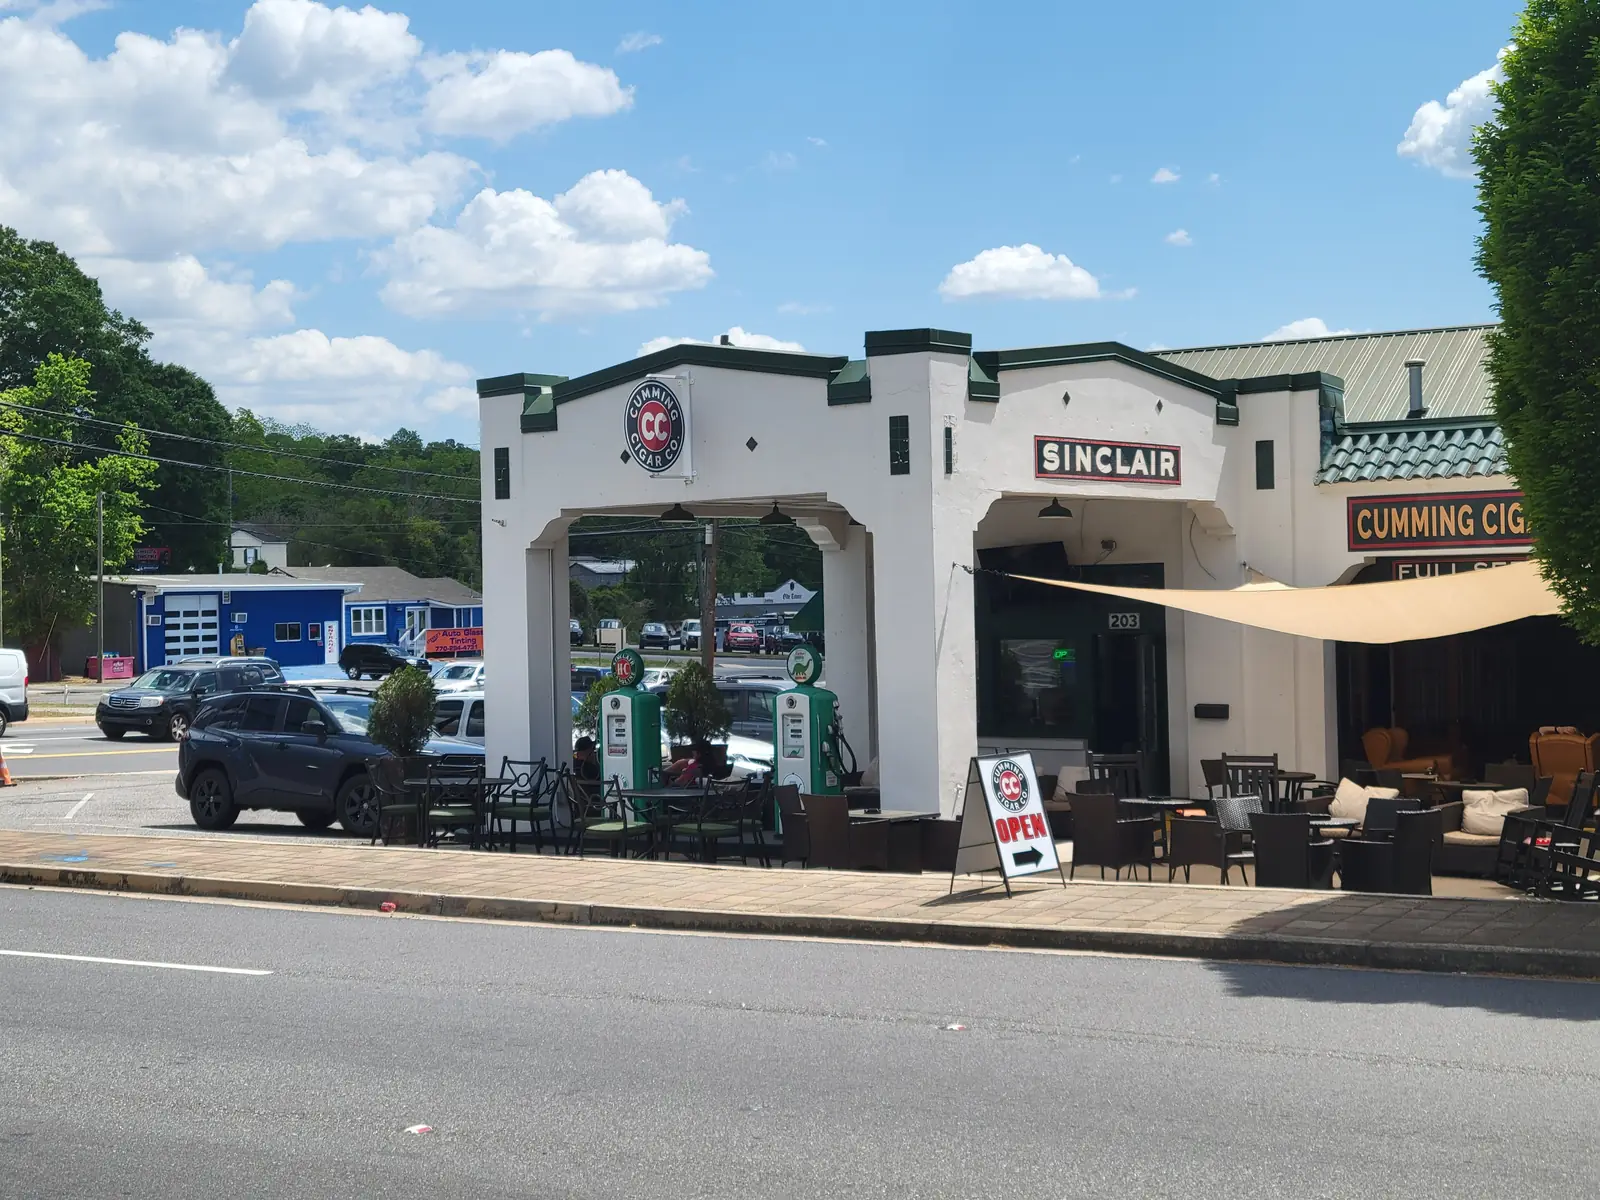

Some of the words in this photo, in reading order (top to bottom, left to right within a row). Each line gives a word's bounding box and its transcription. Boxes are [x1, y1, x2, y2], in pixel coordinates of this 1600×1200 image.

[629, 386, 679, 421] CUMMING
[641, 411, 668, 441] CC
[631, 432, 662, 467] CIGAR
[665, 435, 680, 460] CO.
[1042, 442, 1175, 477] SINCLAIR
[1356, 504, 1475, 540] CUMMING
[1111, 614, 1138, 628] 203
[449, 637, 476, 645] Tinting
[617, 662, 630, 676] HC
[993, 761, 1024, 784] CUMMING
[1001, 776, 1020, 796] CC
[997, 791, 1020, 811] CIGAR
[995, 812, 1048, 844] OPEN
